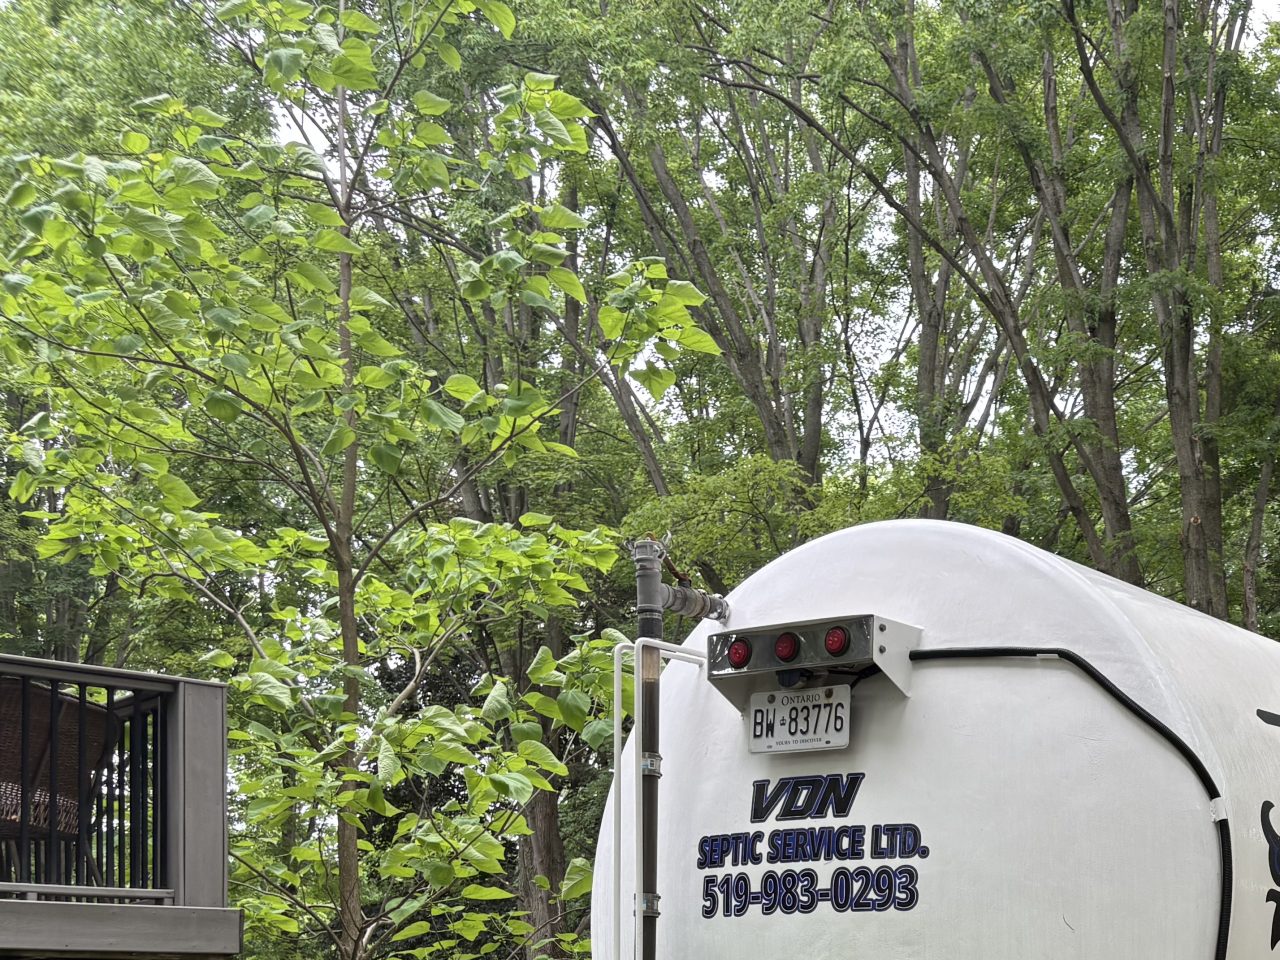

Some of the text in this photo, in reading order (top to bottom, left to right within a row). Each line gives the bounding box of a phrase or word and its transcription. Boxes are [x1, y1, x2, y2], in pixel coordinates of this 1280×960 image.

[753, 702, 845, 739] BW 83776
[781, 694, 820, 706] ONTARIO
[750, 773, 865, 823] VDN
[697, 823, 930, 869] SEPTIC SERVICE LTD.
[702, 865, 919, 919] 519-983-0293
